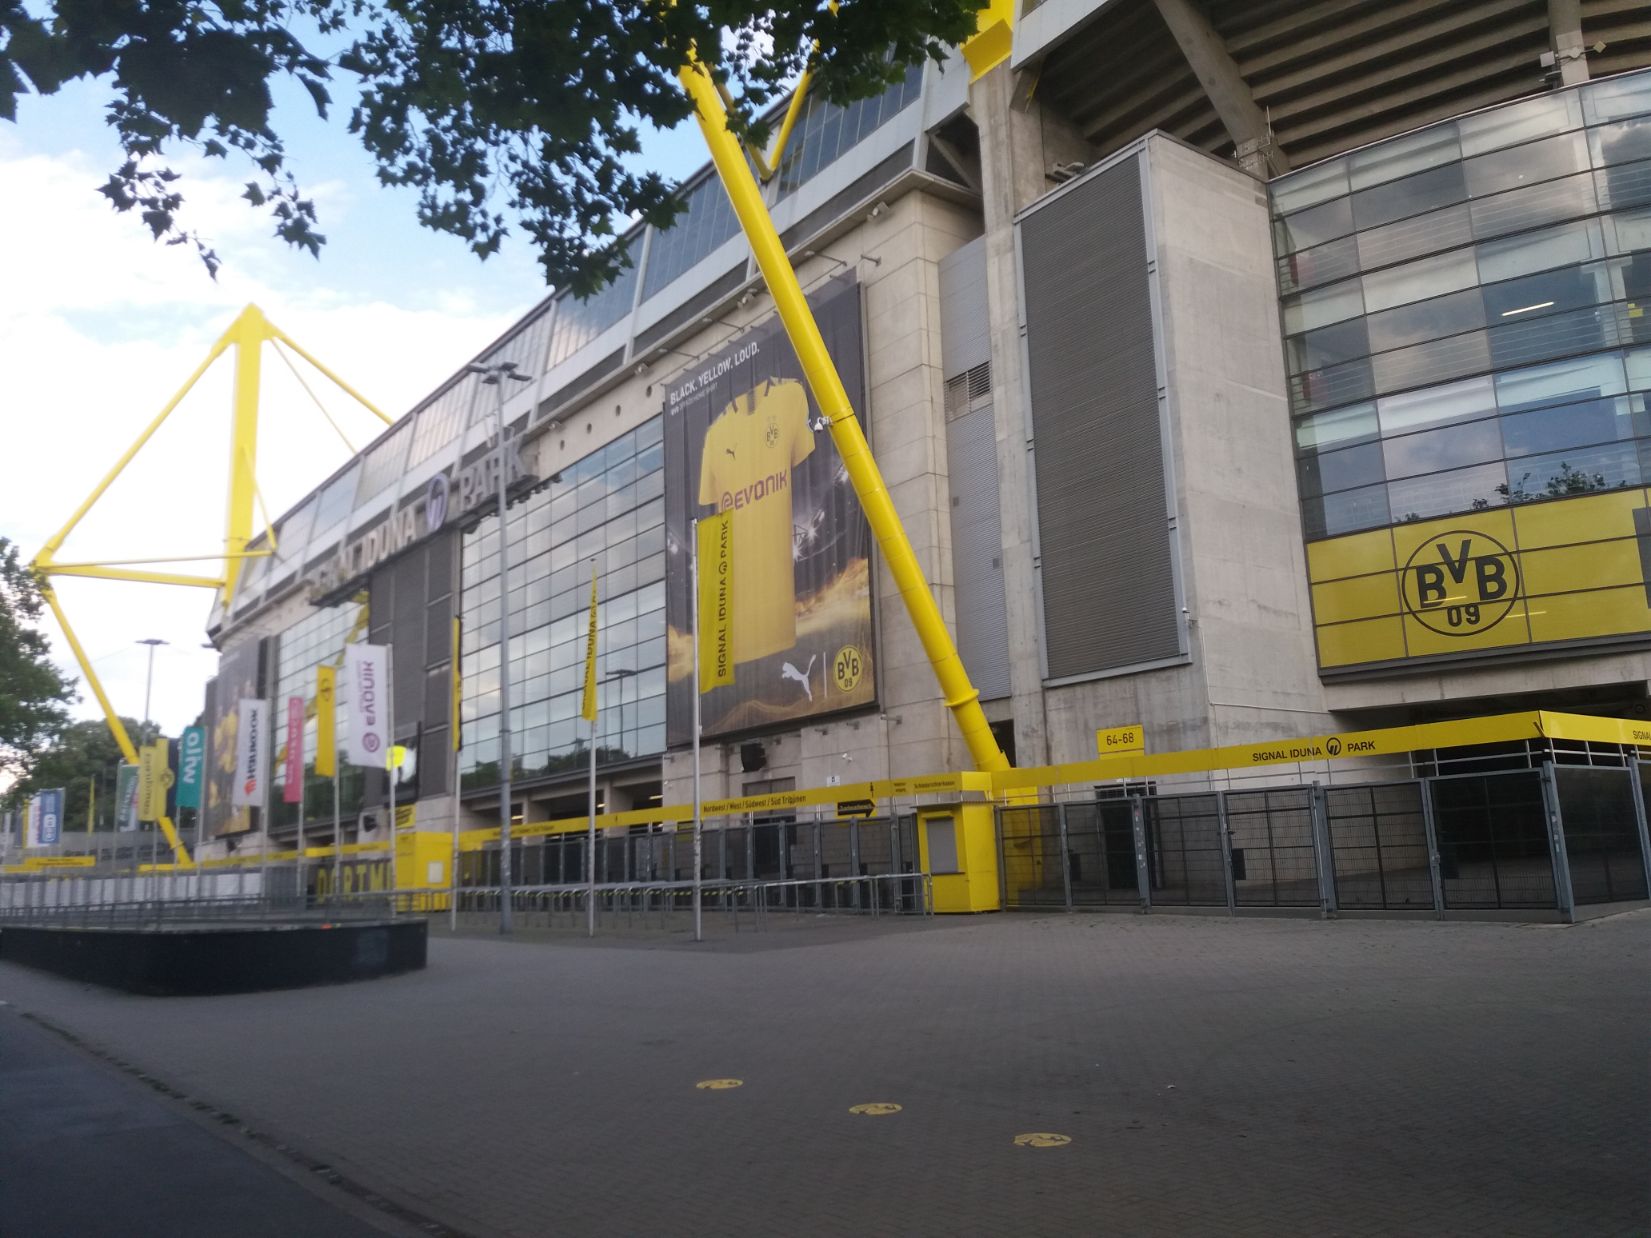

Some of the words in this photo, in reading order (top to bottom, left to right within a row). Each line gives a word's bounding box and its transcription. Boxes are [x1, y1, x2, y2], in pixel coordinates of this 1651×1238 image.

[669, 379, 698, 406] BLACK.
[698, 356, 733, 388] YELLOW.
[734, 341, 760, 367] LOUD.
[734, 468, 788, 511] EVONIK
[719, 520, 729, 559] PARK
[1416, 538, 1508, 609] BVB
[717, 576, 727, 621] IDUNA
[1446, 604, 1481, 628] 09
[717, 625, 727, 678] SIGNAL
[838, 650, 860, 682] BVB
[844, 677, 853, 689] 09
[1105, 731, 1135, 747] 64-68
[1252, 748, 1288, 763] SIGNAL
[1289, 745, 1322, 760] IDUNA
[1347, 739, 1376, 753] PARK
